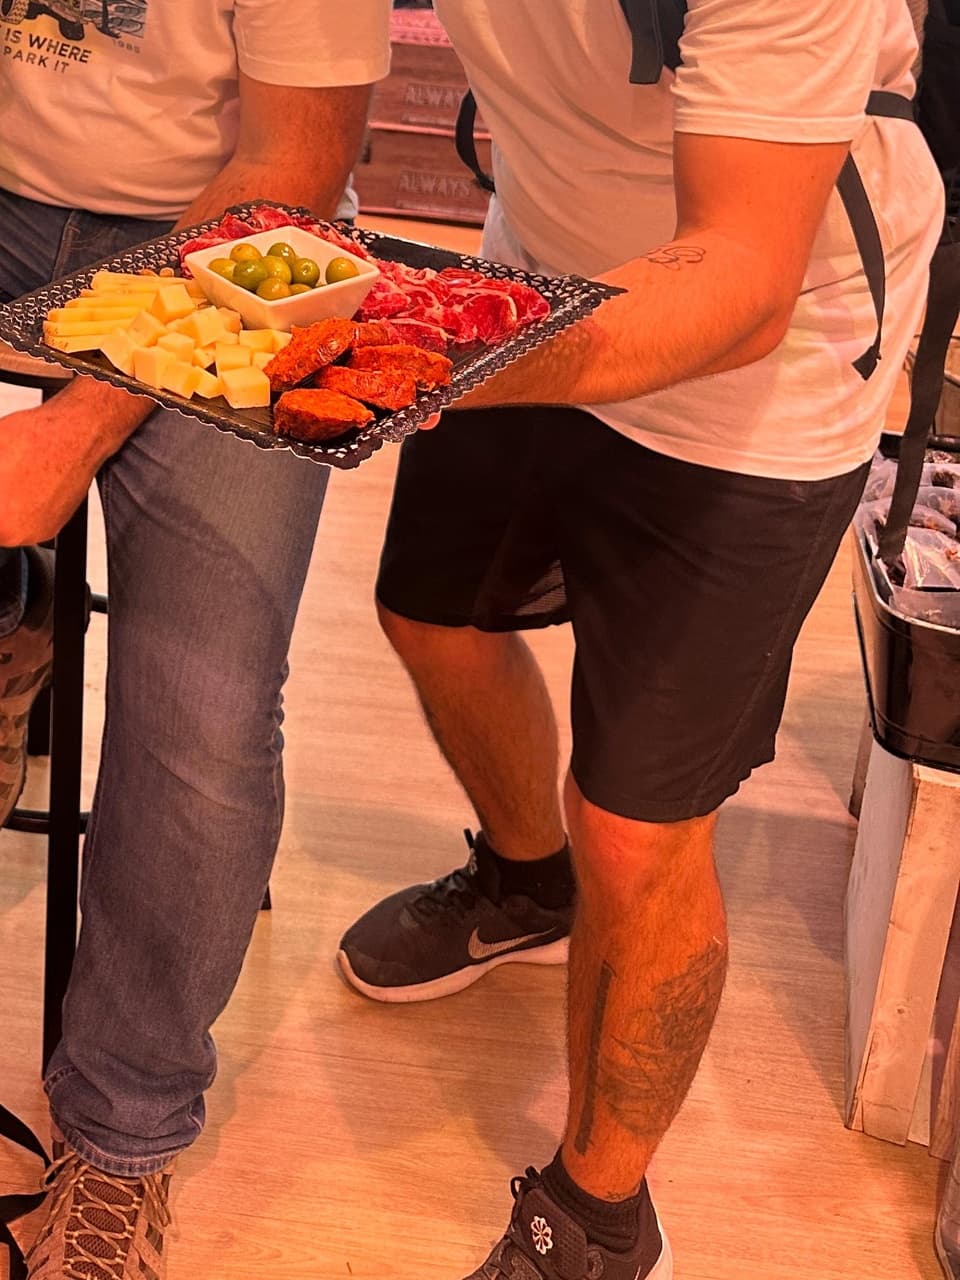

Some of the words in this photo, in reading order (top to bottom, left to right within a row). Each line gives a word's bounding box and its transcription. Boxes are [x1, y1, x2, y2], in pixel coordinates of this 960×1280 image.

[3, 45, 49, 69] PARK
[53, 59, 71, 74] IT
[4, 27, 23, 44] IS
[28, 32, 93, 64] WHERE
[404, 83, 466, 107] ALWAY
